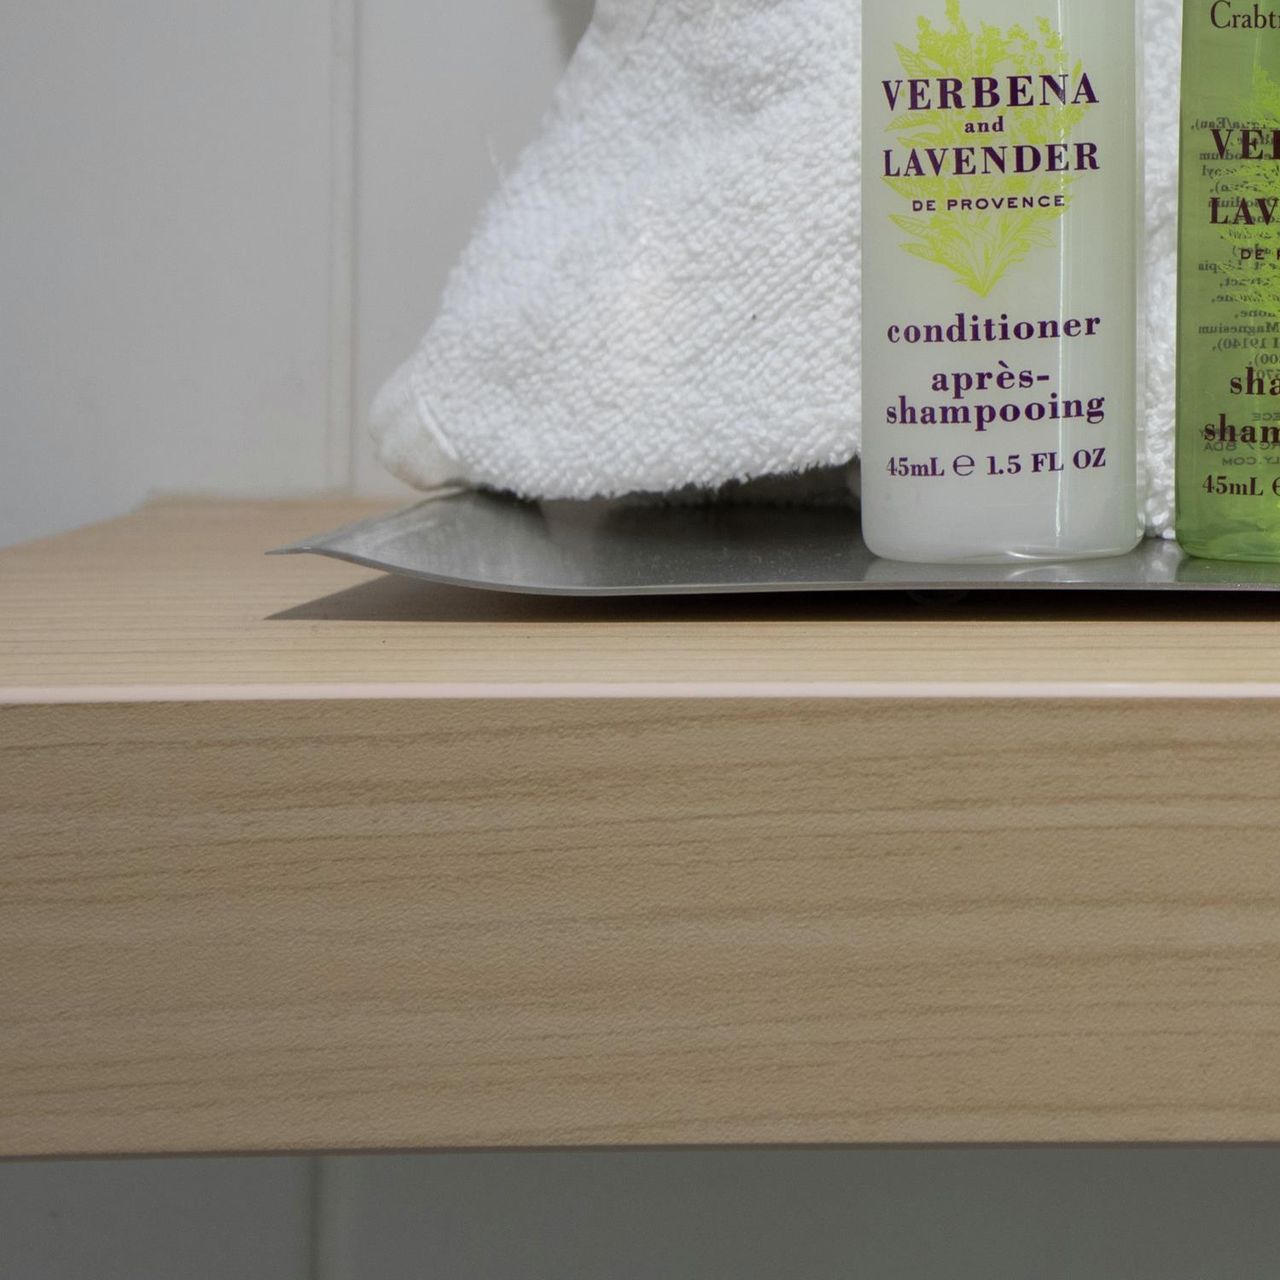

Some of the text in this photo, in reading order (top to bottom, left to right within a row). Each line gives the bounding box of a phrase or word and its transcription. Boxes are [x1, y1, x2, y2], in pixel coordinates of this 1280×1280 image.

[881, 72, 1099, 111] VERBENA
[964, 116, 1004, 133] and
[883, 142, 1100, 177] LAVENDER
[912, 195, 1064, 211] DE PROVENCE
[1240, 249, 1265, 260] DE
[887, 313, 1101, 343] conditioner
[931, 360, 1050, 399] après-
[886, 392, 1105, 431] shampooing
[887, 457, 944, 477] 45mL
[986, 454, 1021, 475] 1.5
[1031, 452, 1064, 473] FL
[1073, 447, 1106, 470] OZ
[1202, 474, 1263, 497] 45mL
